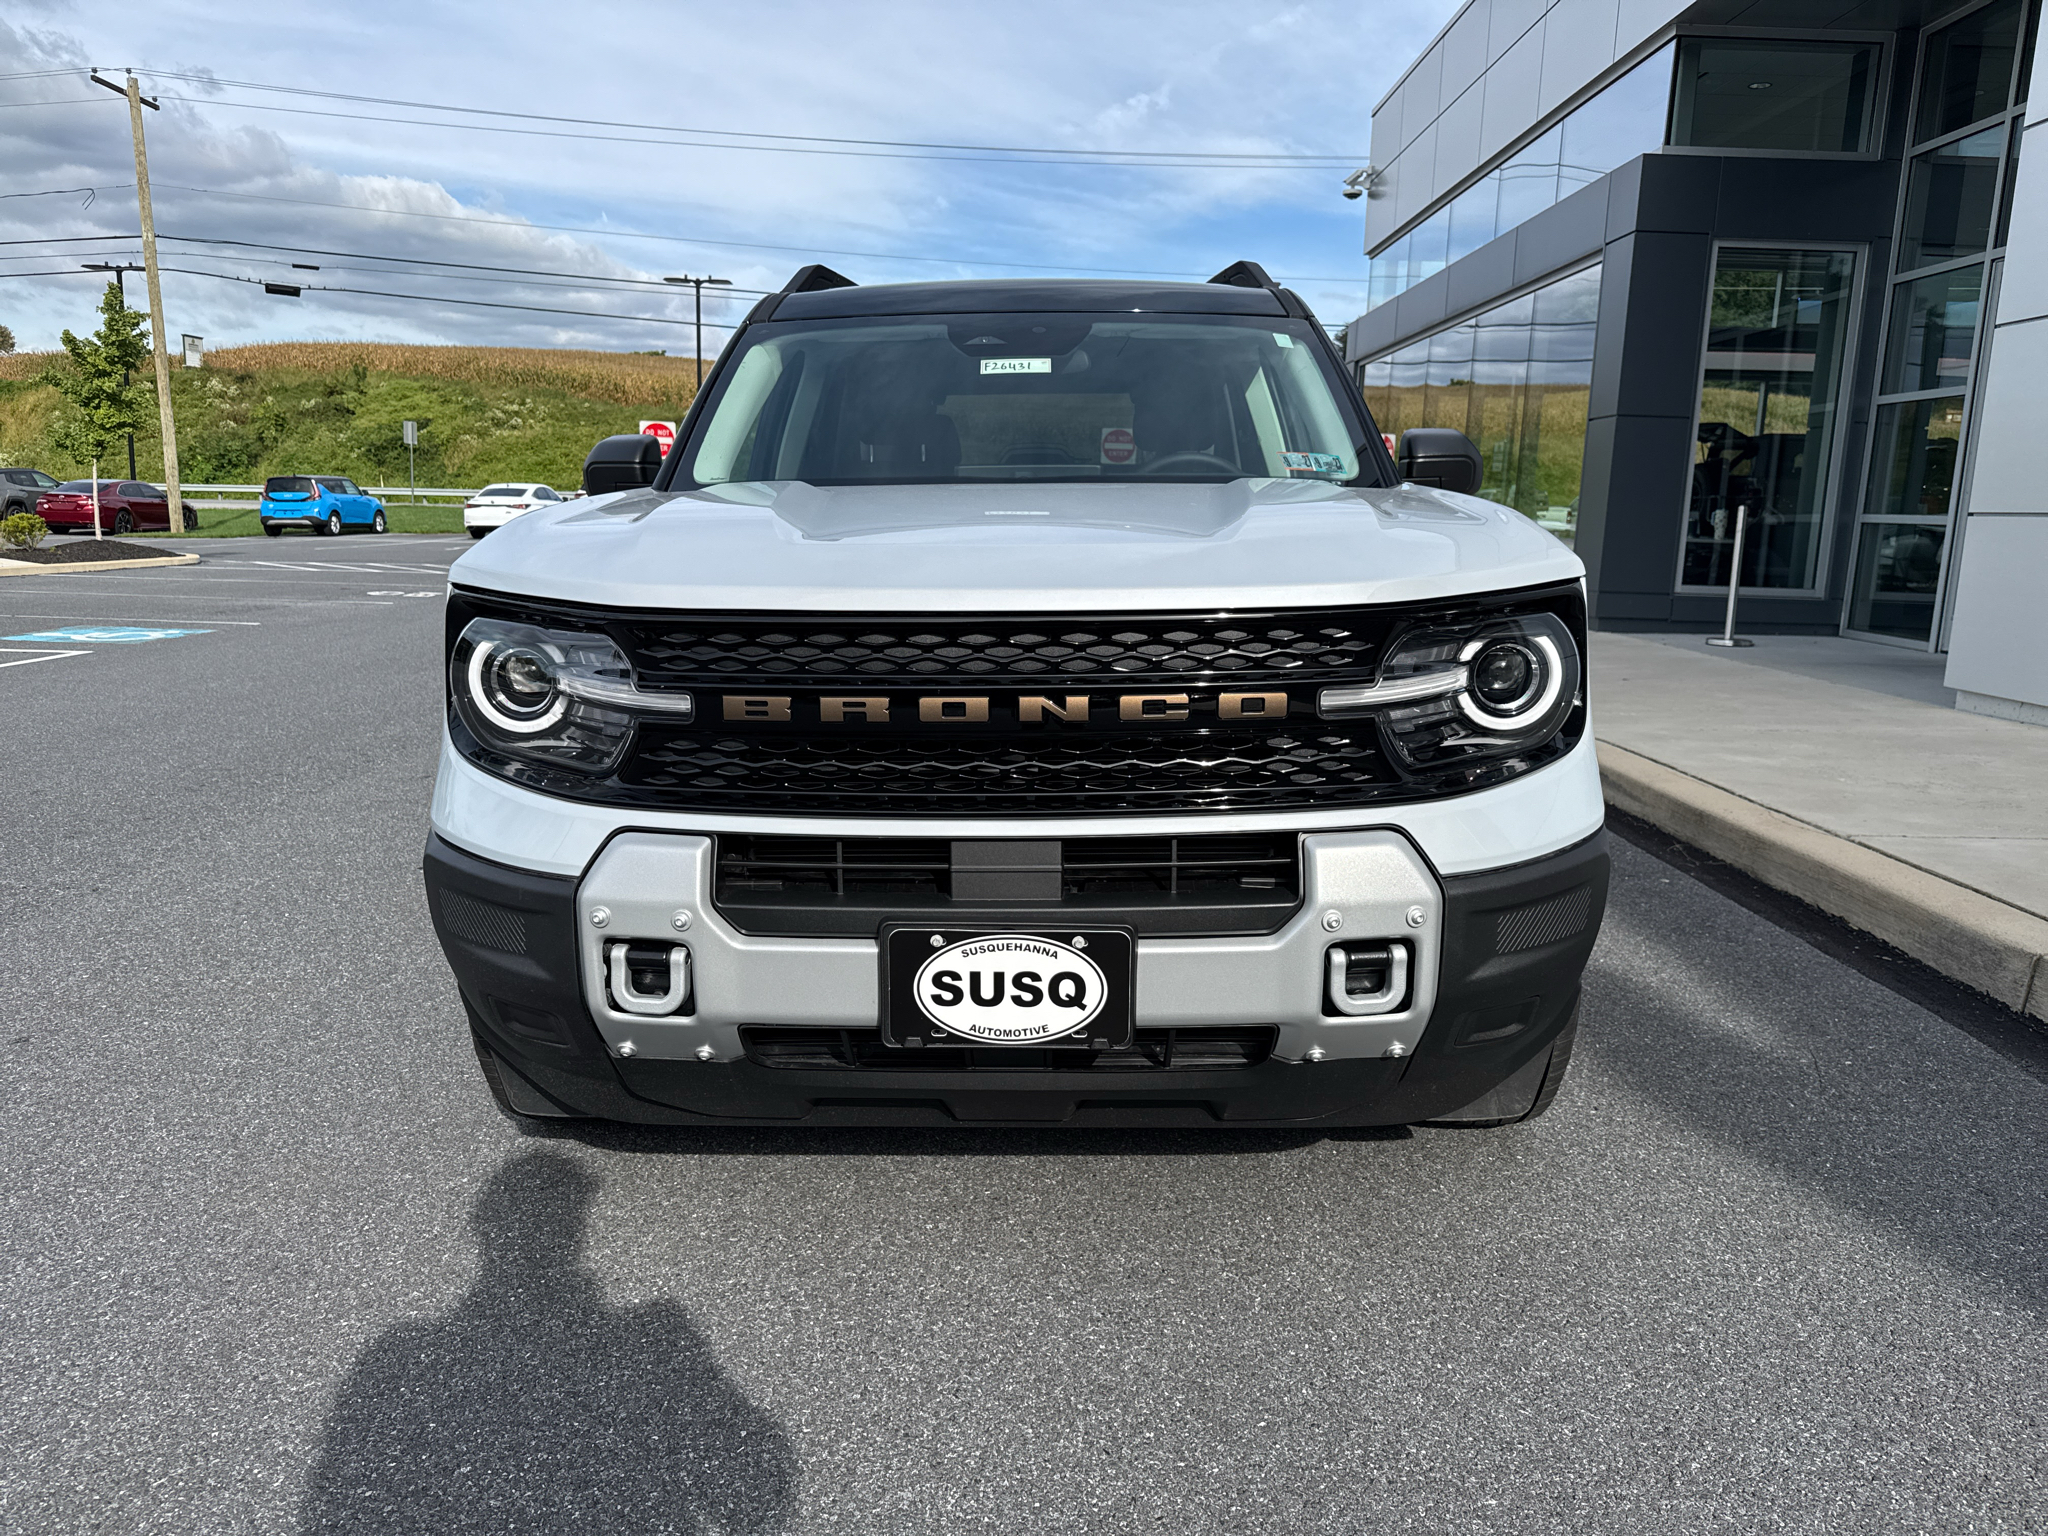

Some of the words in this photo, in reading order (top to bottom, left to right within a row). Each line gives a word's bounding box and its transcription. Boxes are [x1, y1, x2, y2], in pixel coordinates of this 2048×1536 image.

[984, 362, 1031, 371] F26431
[722, 692, 1289, 723] BRONCO
[960, 942, 1059, 960] SUSQUEHANNA
[930, 969, 1088, 1011] SUSQ
[968, 1023, 1050, 1038] AUTOMOTIVE
